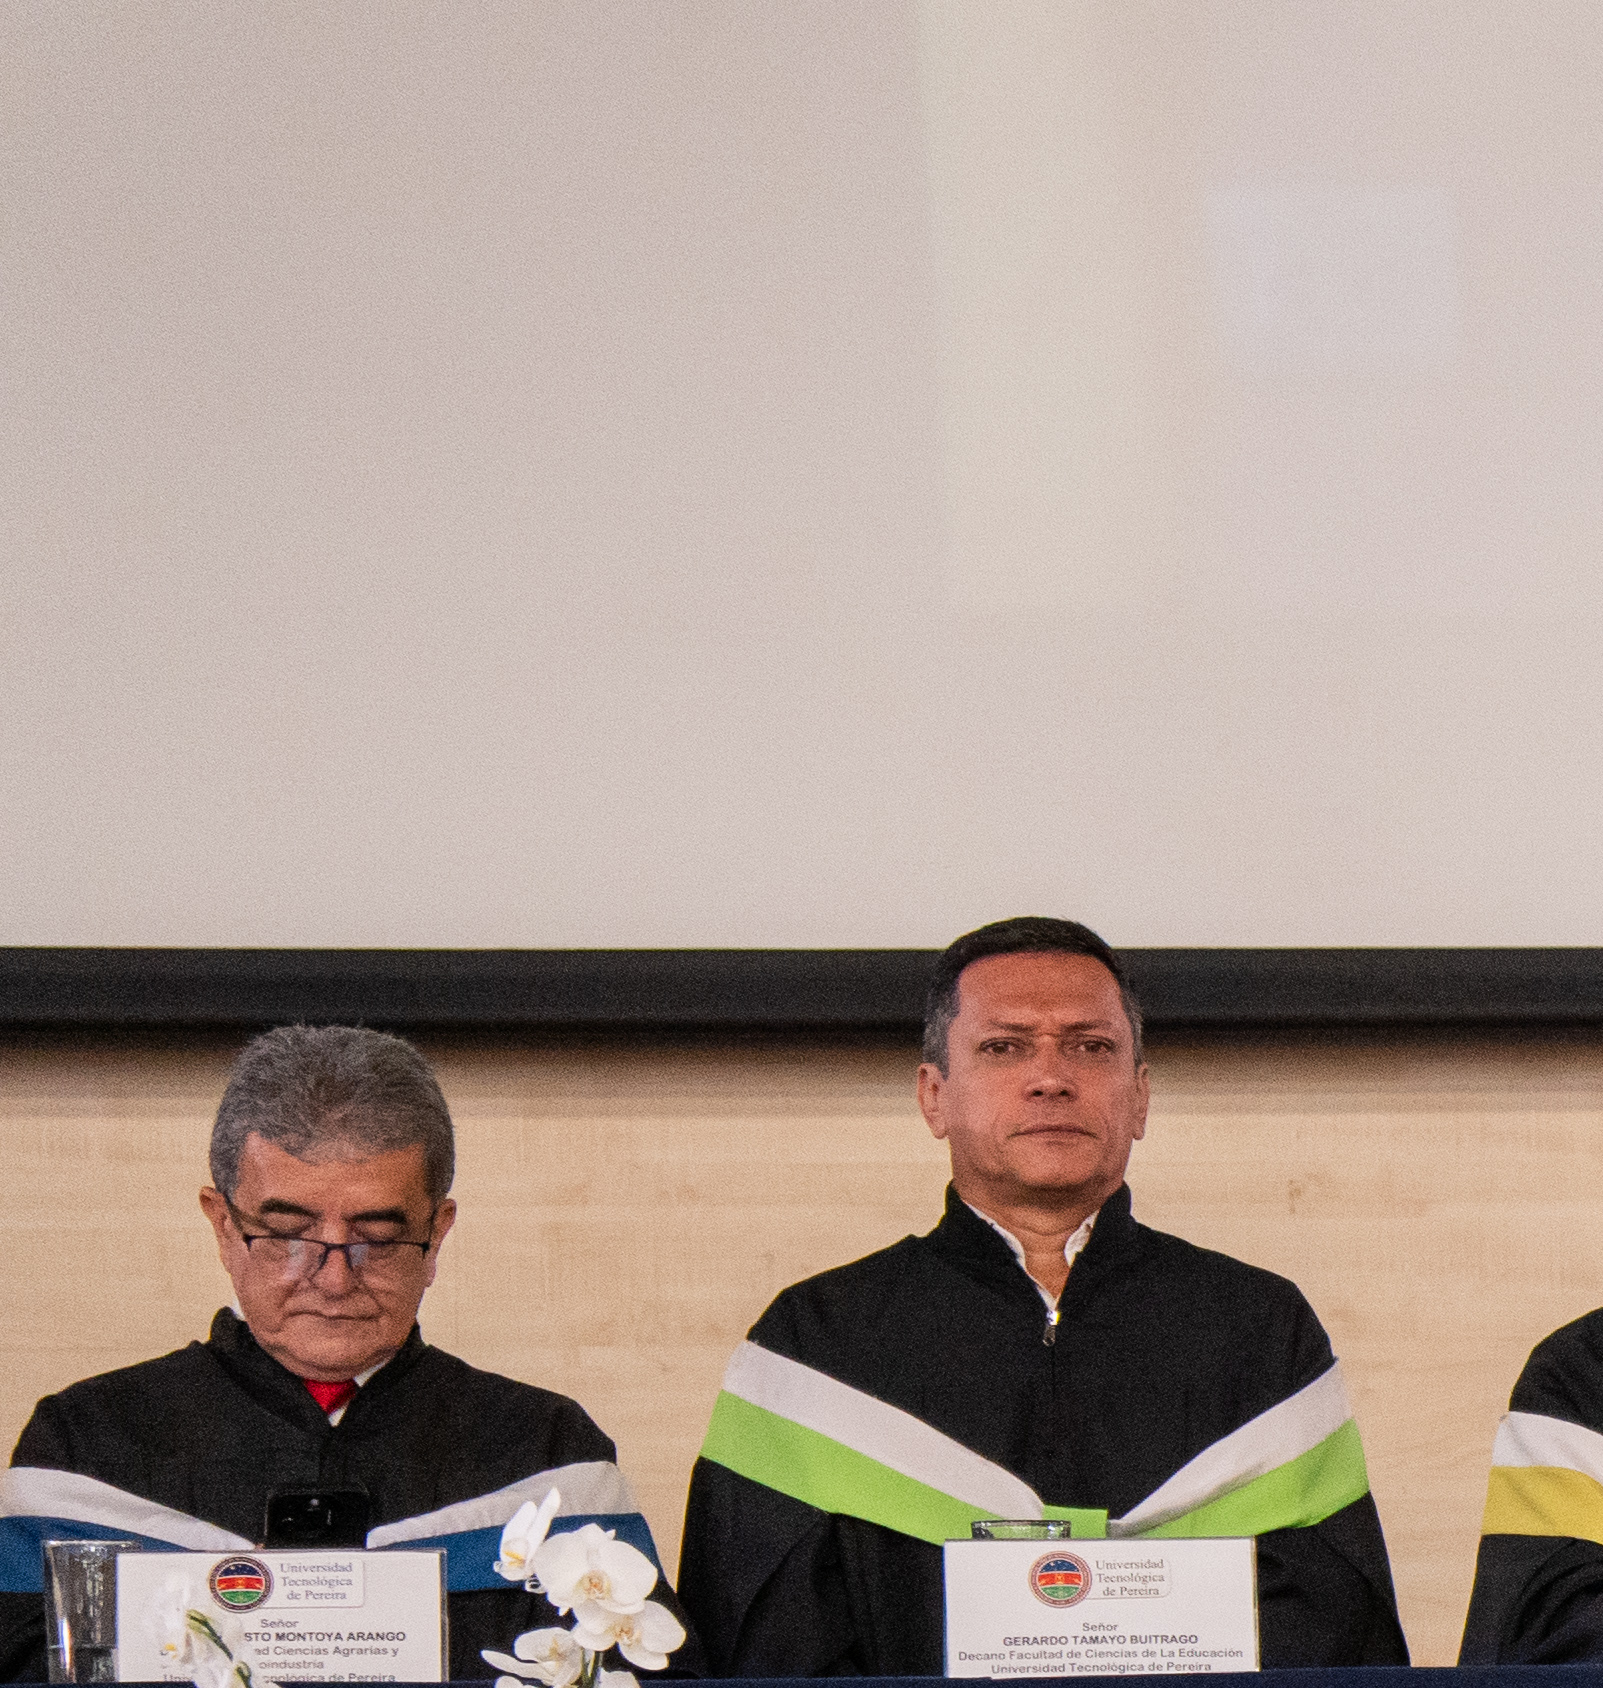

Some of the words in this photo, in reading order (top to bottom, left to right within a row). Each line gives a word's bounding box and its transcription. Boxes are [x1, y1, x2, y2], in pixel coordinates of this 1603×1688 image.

[280, 1562, 353, 1573] Universidad
[1095, 1559, 1165, 1570] Universidad
[1096, 1572, 1166, 1585] Tecnológica
[286, 1590, 301, 1600] de
[305, 1590, 347, 1600] Pereira
[1102, 1586, 1116, 1596] de
[1119, 1586, 1160, 1596] Pereira
[260, 1618, 299, 1629] Señor
[1082, 1622, 1118, 1632] Señor
[244, 1632, 271, 1642] STO
[275, 1631, 344, 1642] MONTOYA
[346, 1631, 406, 1642] ARANGO
[1002, 1636, 1069, 1647] GERARDO
[1071, 1635, 1127, 1645] TAMAYO
[1129, 1634, 1199, 1645] BUITRAGO
[273, 1646, 329, 1656] Ciencias
[332, 1646, 389, 1657] Agrarias
[391, 1647, 400, 1657] y
[958, 1651, 1006, 1661] Decano
[1009, 1650, 1064, 1660] Facultad
[1066, 1649, 1081, 1659] de
[1084, 1649, 1138, 1659] Ciencias
[1141, 1649, 1157, 1658] de
[1160, 1648, 1175, 1658] La
[1178, 1648, 1244, 1658] Educación
[258, 1660, 325, 1670] oindustria
[991, 1663, 1066, 1674] Universidad
[1068, 1662, 1145, 1674] Tecnológica
[1148, 1662, 1163, 1672] de
[1166, 1661, 1212, 1672] Pereira
